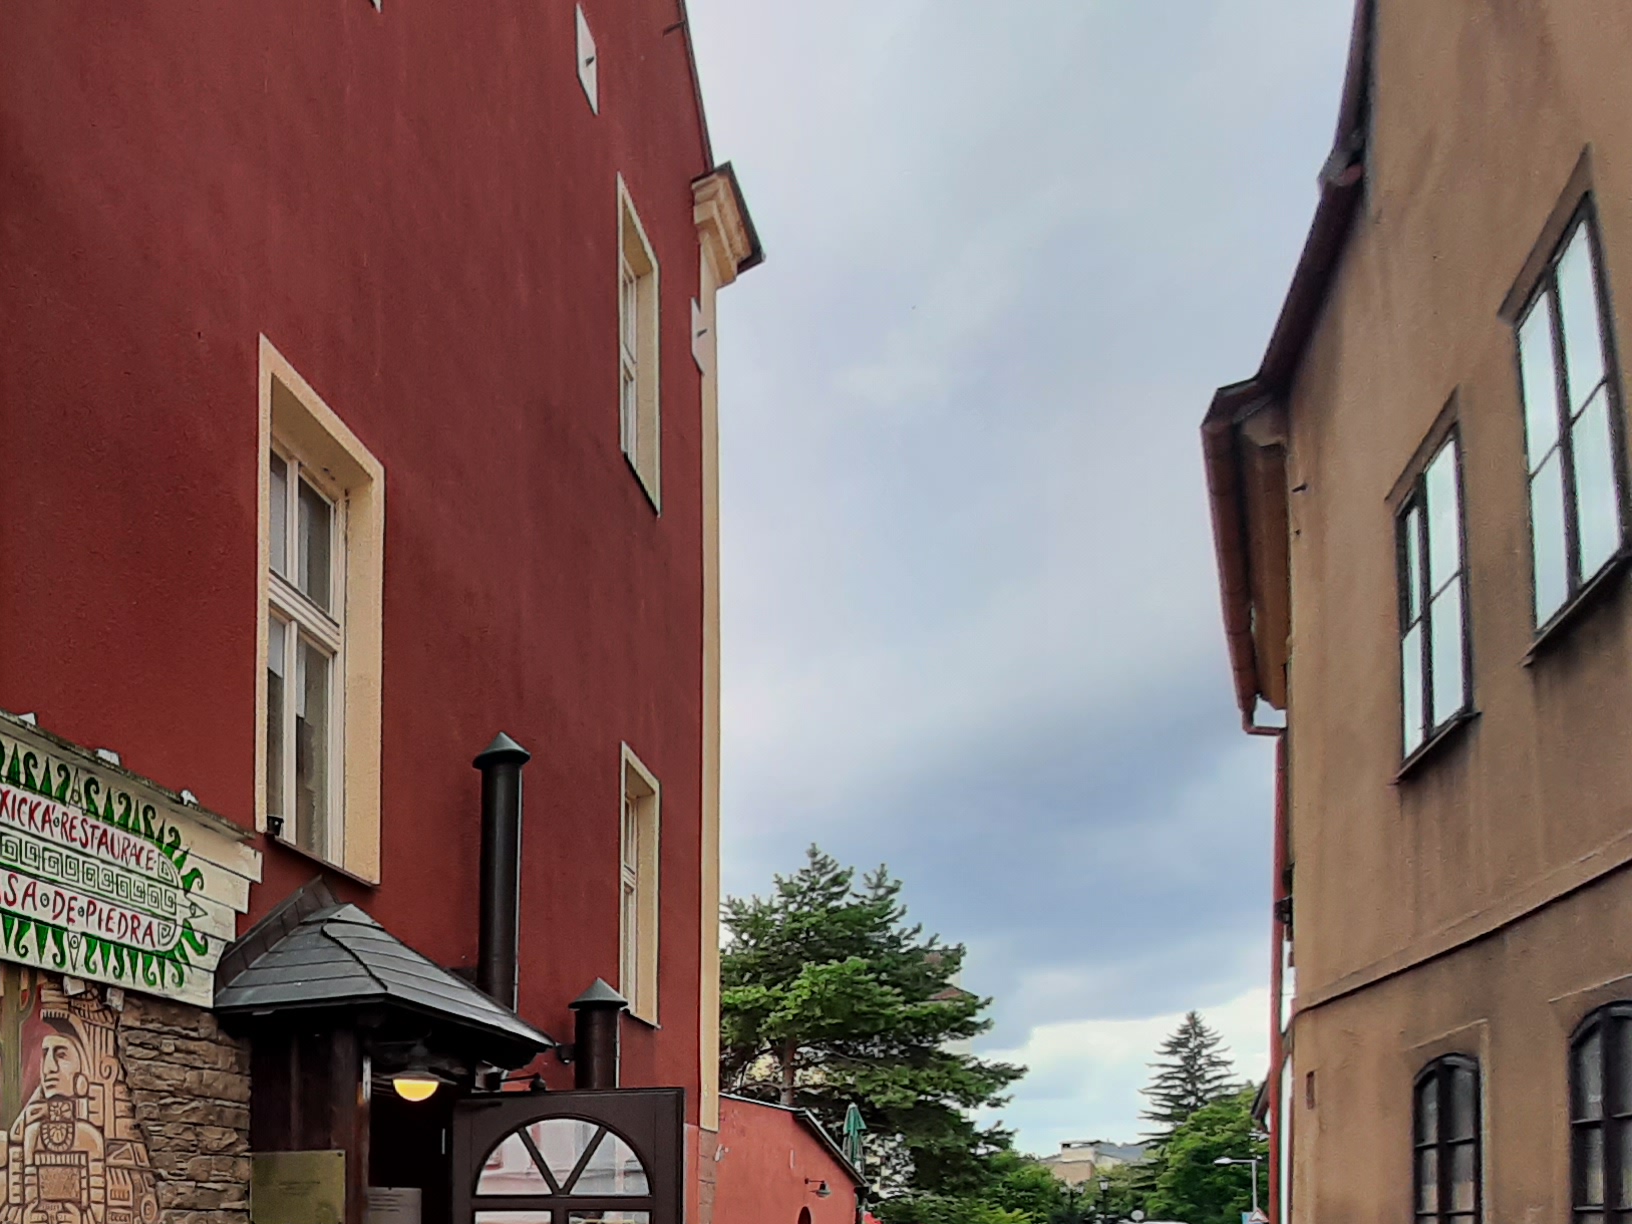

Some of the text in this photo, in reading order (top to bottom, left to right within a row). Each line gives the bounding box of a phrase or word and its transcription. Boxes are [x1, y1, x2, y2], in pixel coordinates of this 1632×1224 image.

[60, 811, 155, 871] RESTAURACE
[52, 890, 78, 926] DE
[86, 899, 156, 949] PIEDRA
